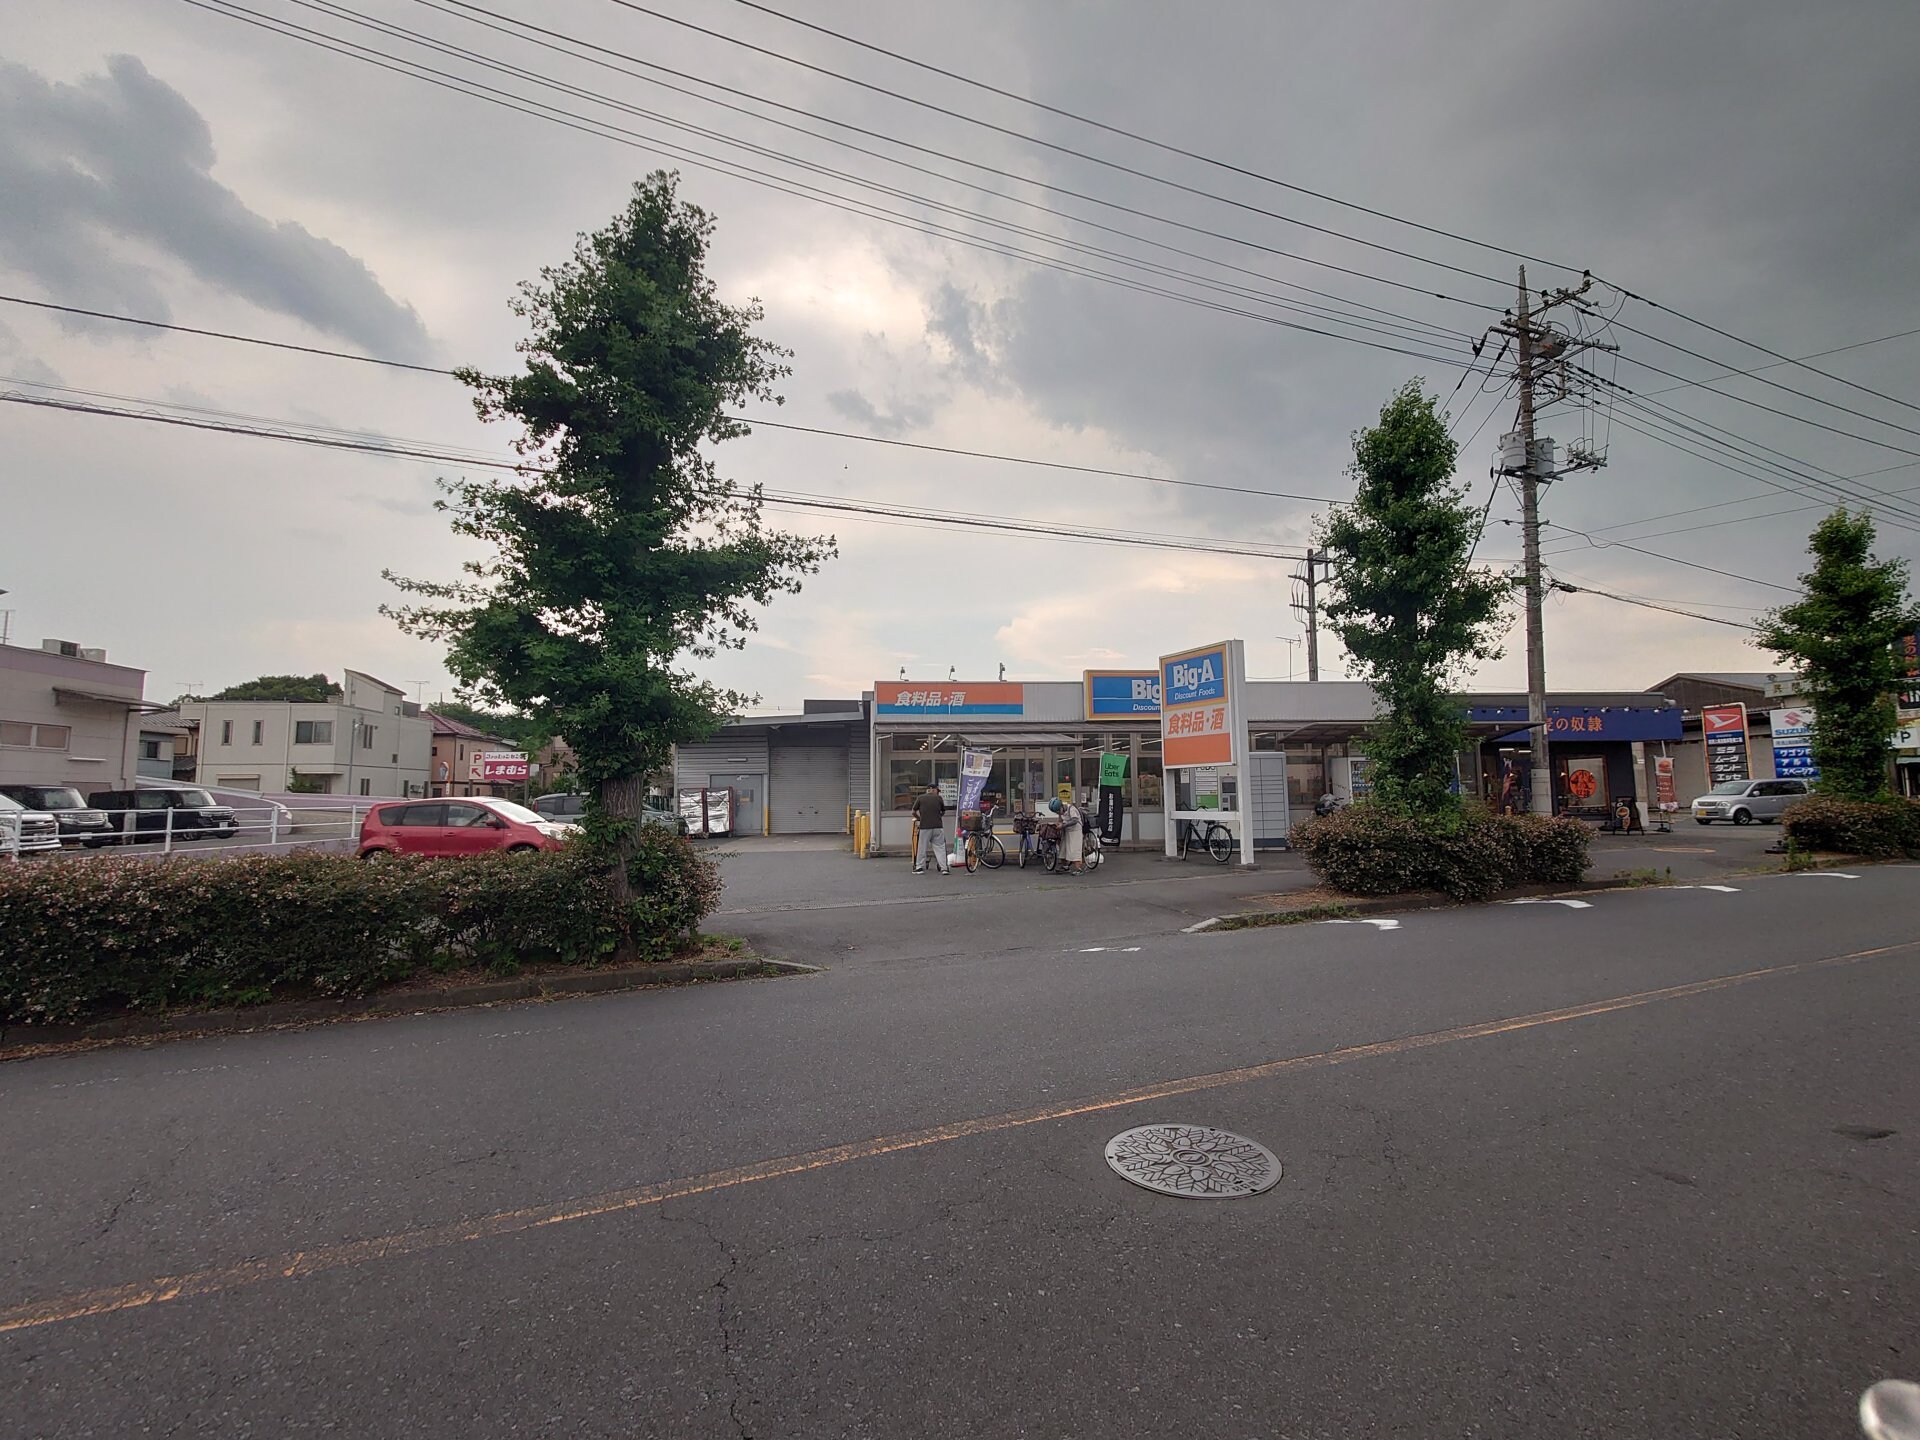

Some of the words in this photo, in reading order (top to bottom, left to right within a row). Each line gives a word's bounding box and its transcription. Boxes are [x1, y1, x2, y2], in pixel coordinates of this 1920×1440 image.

[1174, 690, 1197, 700] Discount
[1199, 687, 1216, 696] Foods
[1716, 746, 1736, 754] ミラ
[474, 754, 482, 764] P
[485, 765, 528, 775] しまむら
[1104, 762, 1120, 770] Uber
[1715, 764, 1742, 772] タント
[1716, 773, 1742, 781] エッセ
